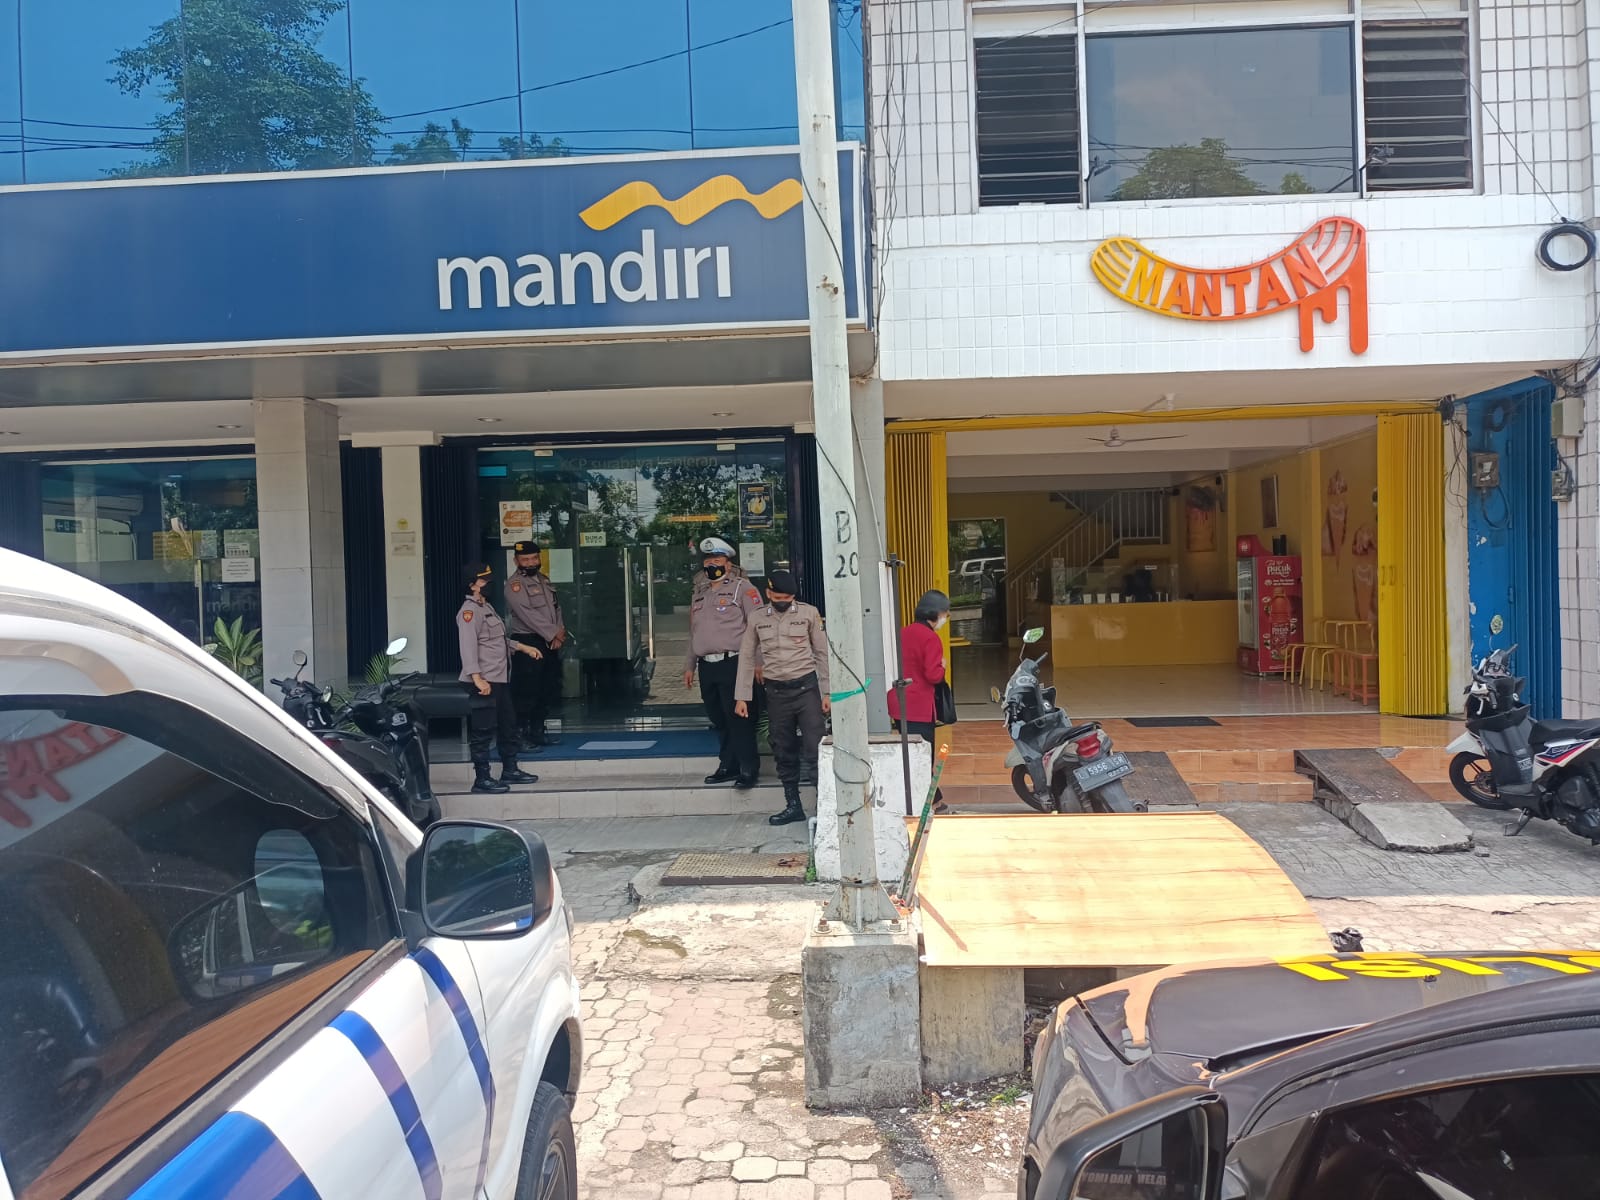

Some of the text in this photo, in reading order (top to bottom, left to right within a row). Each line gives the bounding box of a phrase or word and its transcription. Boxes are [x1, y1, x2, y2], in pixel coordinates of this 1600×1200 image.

[437, 228, 732, 311] mandiri
[1124, 243, 1328, 316] MANTAN
[834, 551, 859, 578] 20
